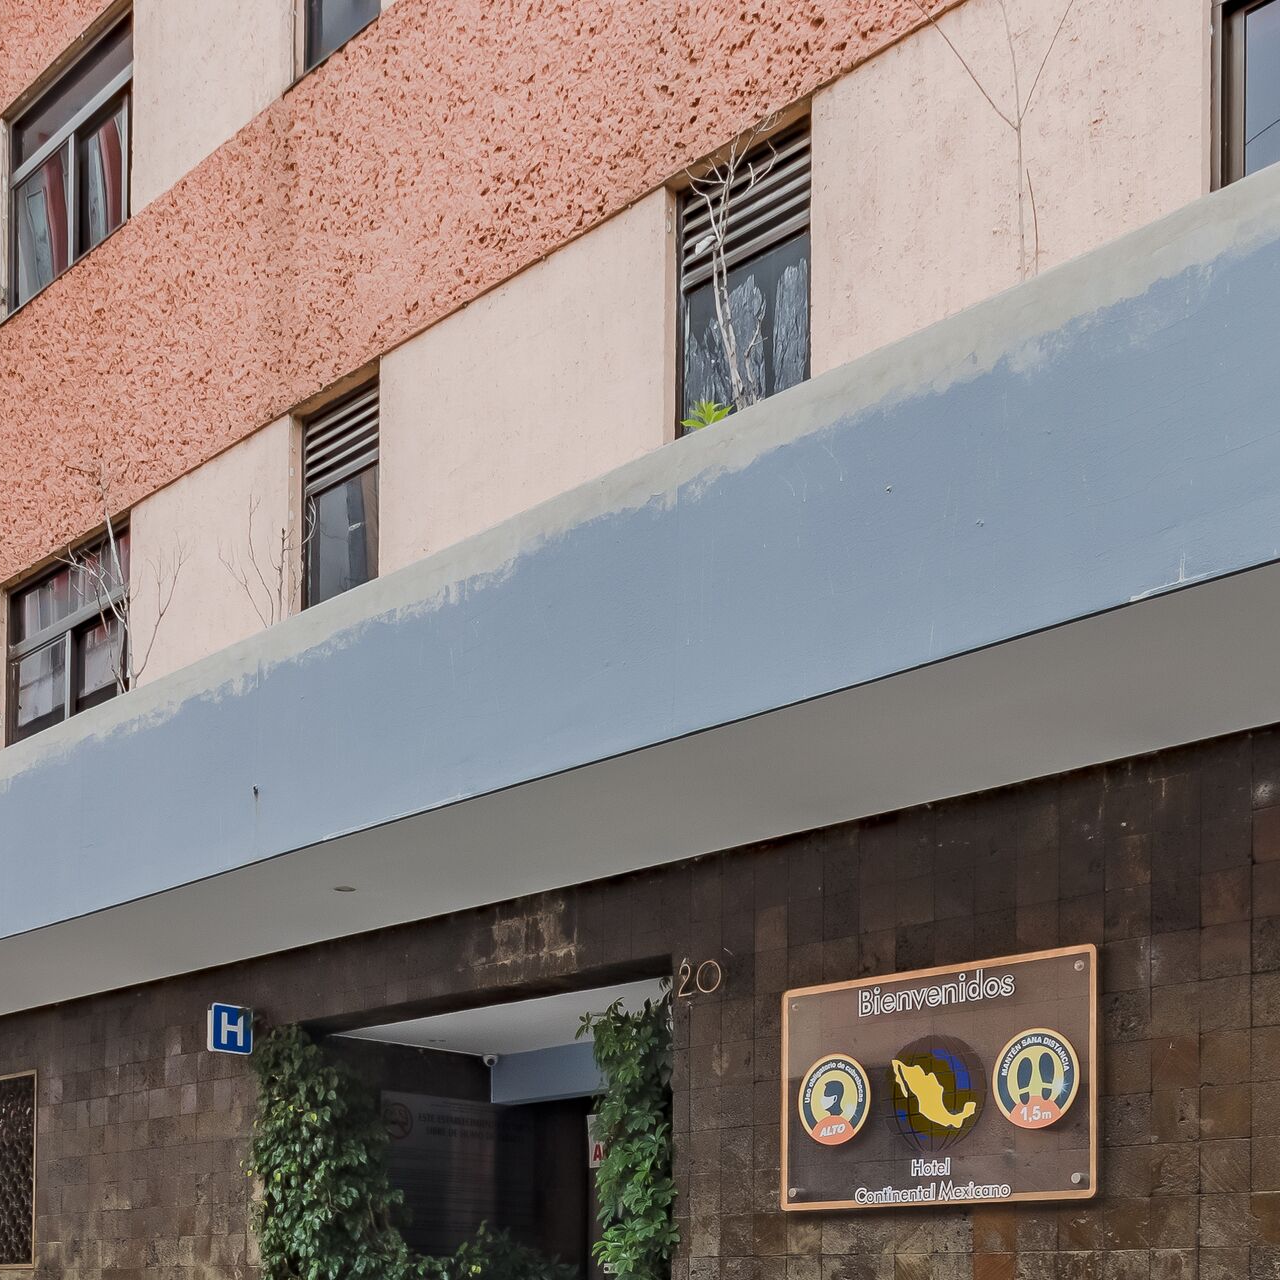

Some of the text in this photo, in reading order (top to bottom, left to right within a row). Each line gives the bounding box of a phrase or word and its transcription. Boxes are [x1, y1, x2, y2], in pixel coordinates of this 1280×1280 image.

[678, 960, 721, 997] 20
[858, 968, 1015, 1018] Bienvenidos
[221, 1011, 244, 1047] H
[1021, 1036, 1042, 1047] SANA
[1043, 1037, 1070, 1072] DISTANCIA
[804, 1088, 812, 1103] Uso
[808, 1062, 836, 1088] obligatorio
[820, 1123, 846, 1137] ALTO
[910, 1157, 951, 1177] Hotel
[855, 1179, 1012, 1205] Continental Mexicano
